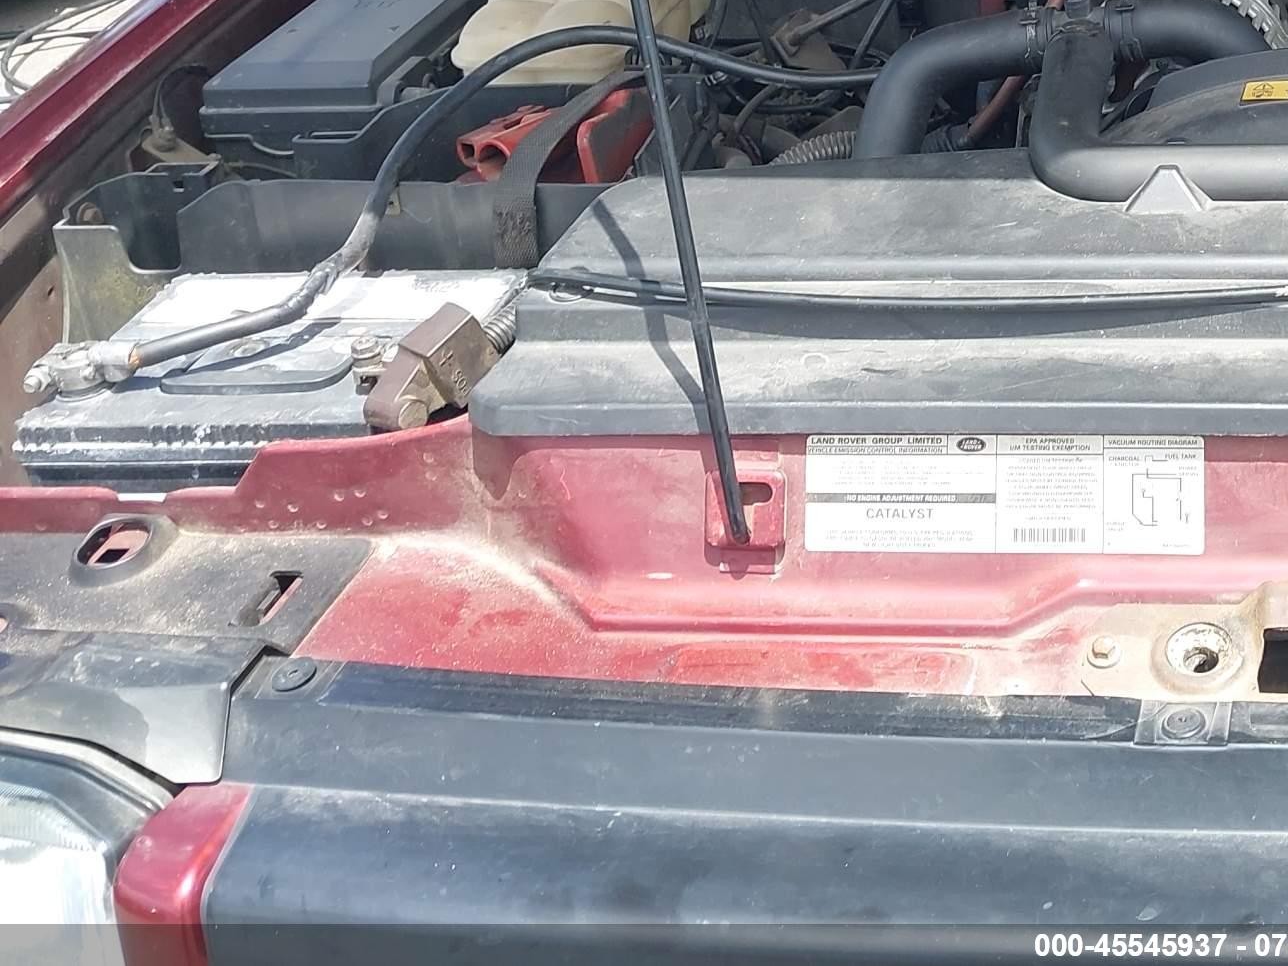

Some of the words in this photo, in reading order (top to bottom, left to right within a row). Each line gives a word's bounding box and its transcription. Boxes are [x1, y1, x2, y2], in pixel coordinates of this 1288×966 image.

[846, 494, 856, 502] NO
[857, 494, 880, 502] ENGINE
[881, 494, 924, 502] ADJUSTMENT
[924, 494, 957, 502] REQUIRED
[866, 508, 934, 520] CATALYST
